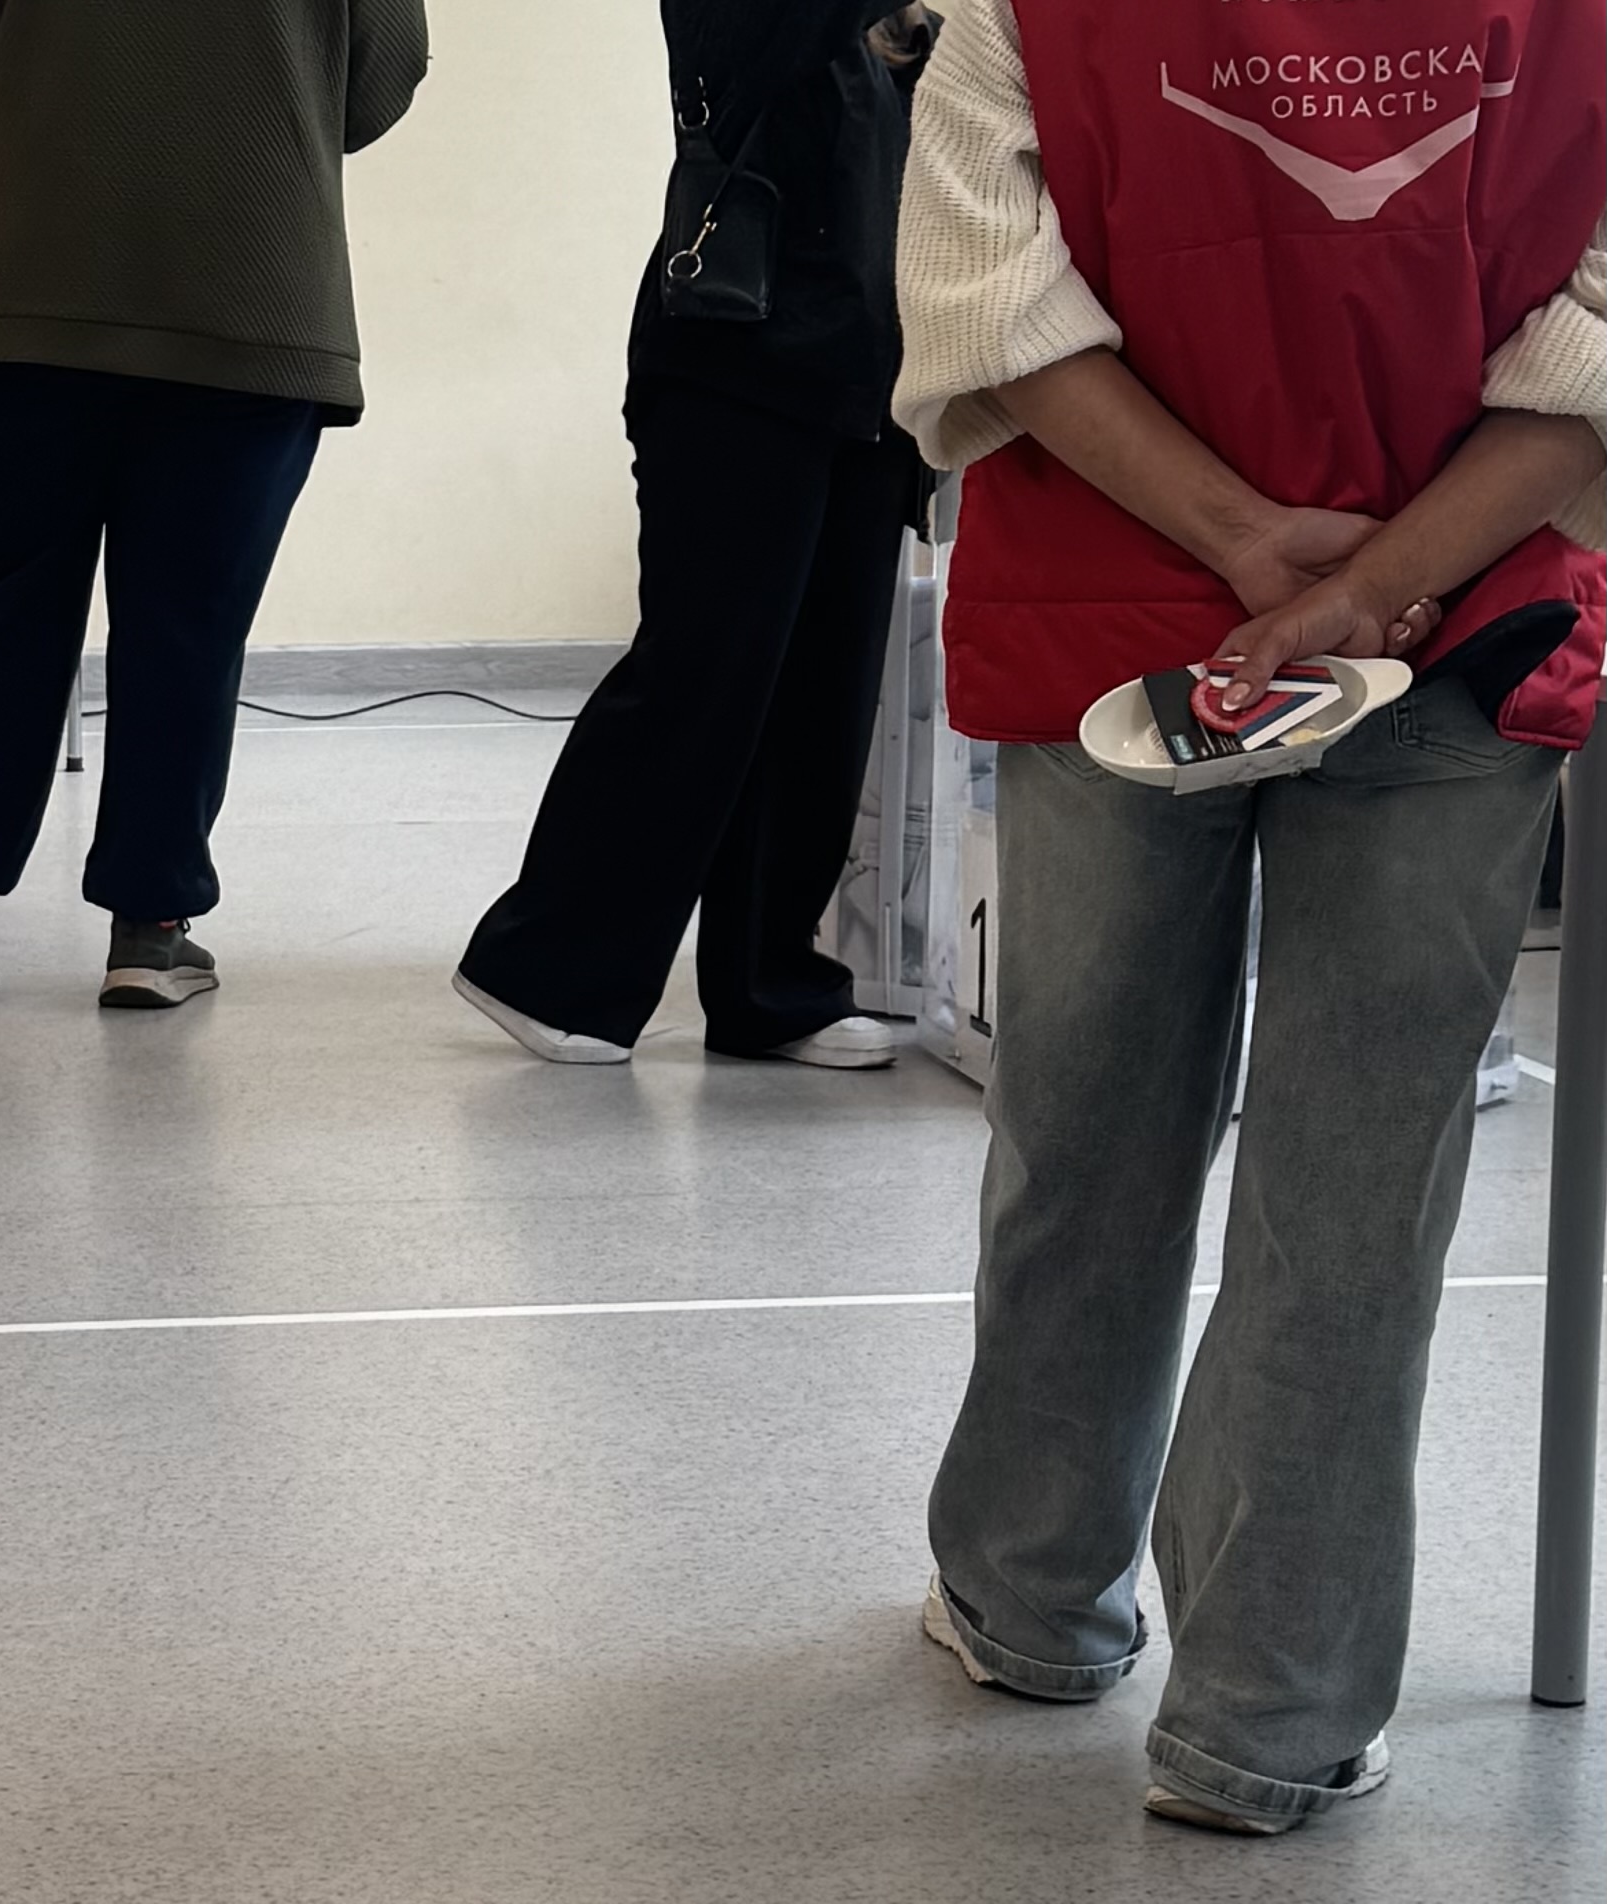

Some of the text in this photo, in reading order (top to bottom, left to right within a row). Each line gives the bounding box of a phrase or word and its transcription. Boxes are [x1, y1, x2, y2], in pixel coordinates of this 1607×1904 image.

[1211, 42, 1483, 91] МОСКОВСКА
[1271, 88, 1438, 120] ОБЛАСТЬ
[969, 896, 993, 1039] 1
